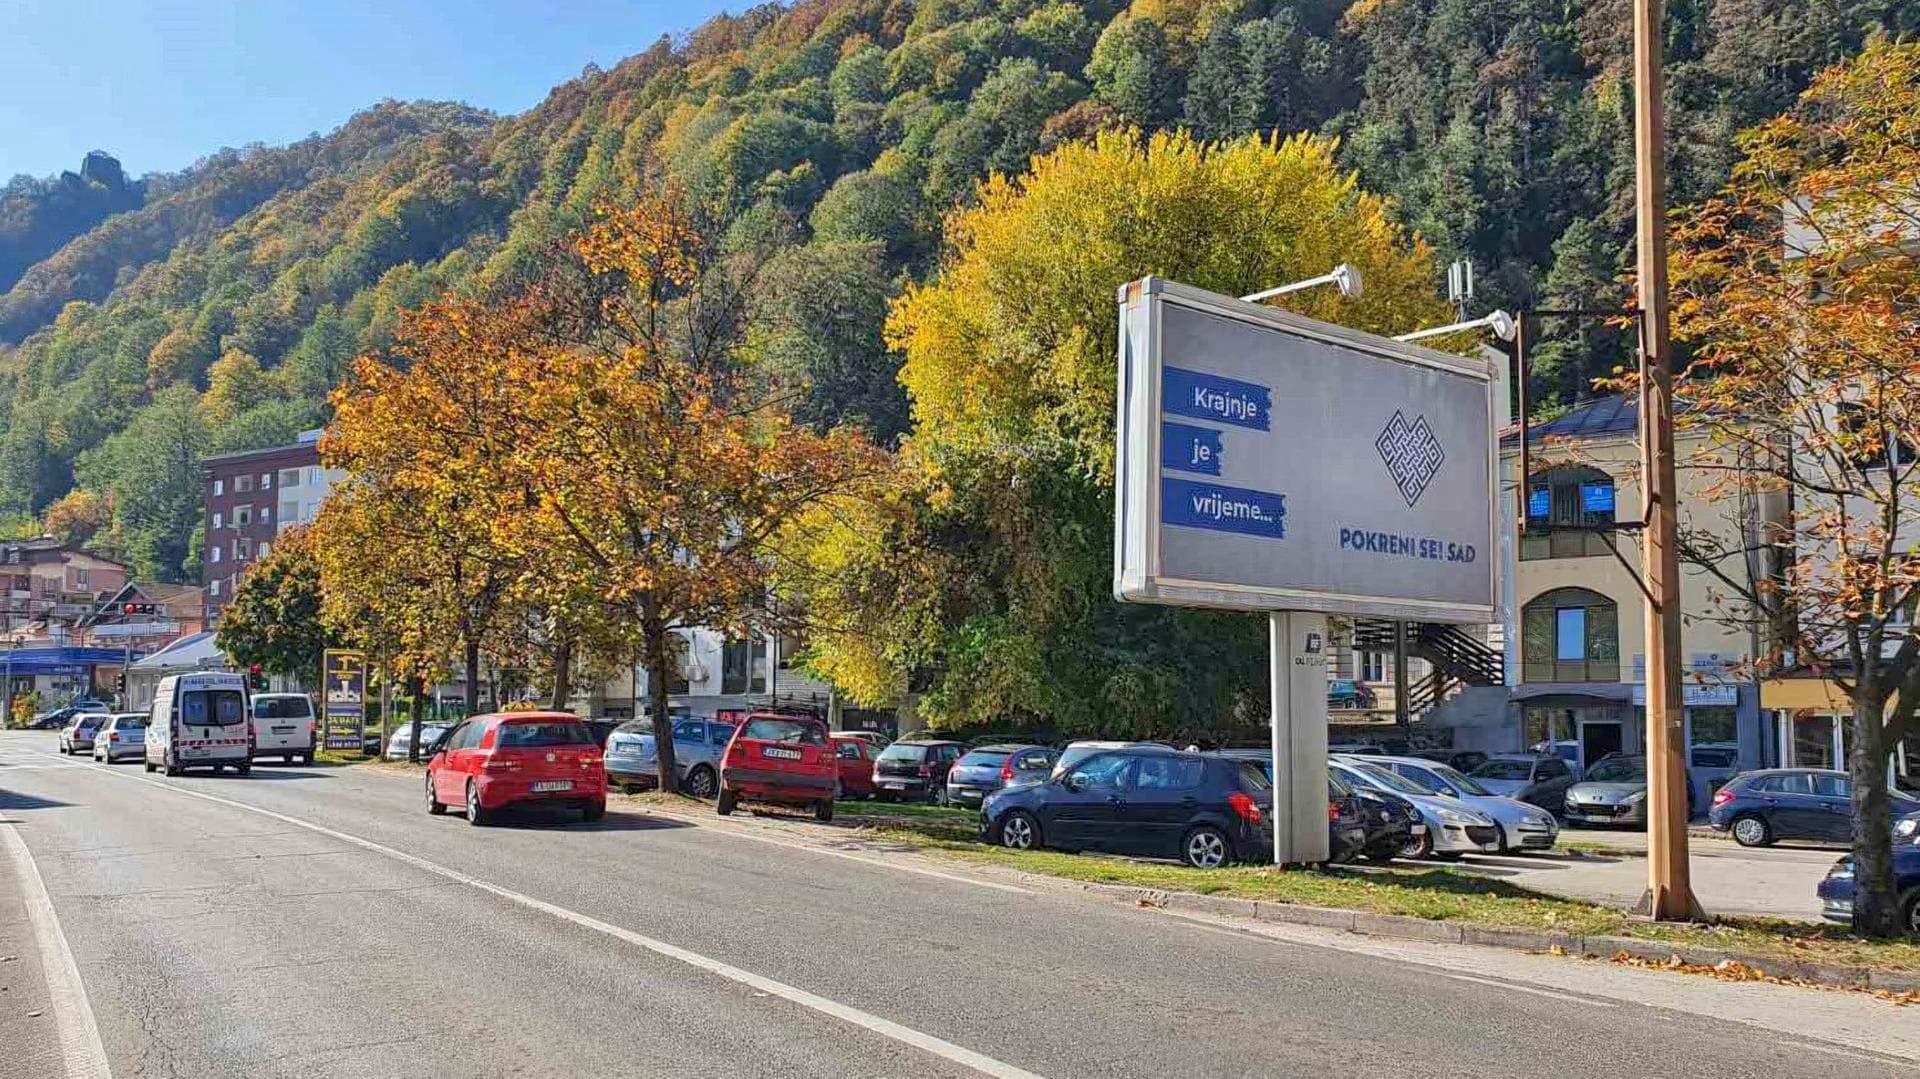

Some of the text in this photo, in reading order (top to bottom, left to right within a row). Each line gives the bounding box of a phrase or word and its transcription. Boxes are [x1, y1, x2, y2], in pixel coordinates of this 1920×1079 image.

[1194, 386, 1257, 420] Krajnje
[1190, 438, 1211, 464] je
[1192, 493, 1273, 523] vrijeme...
[1340, 528, 1415, 557] POKRENI
[1447, 542, 1476, 563] SAD
